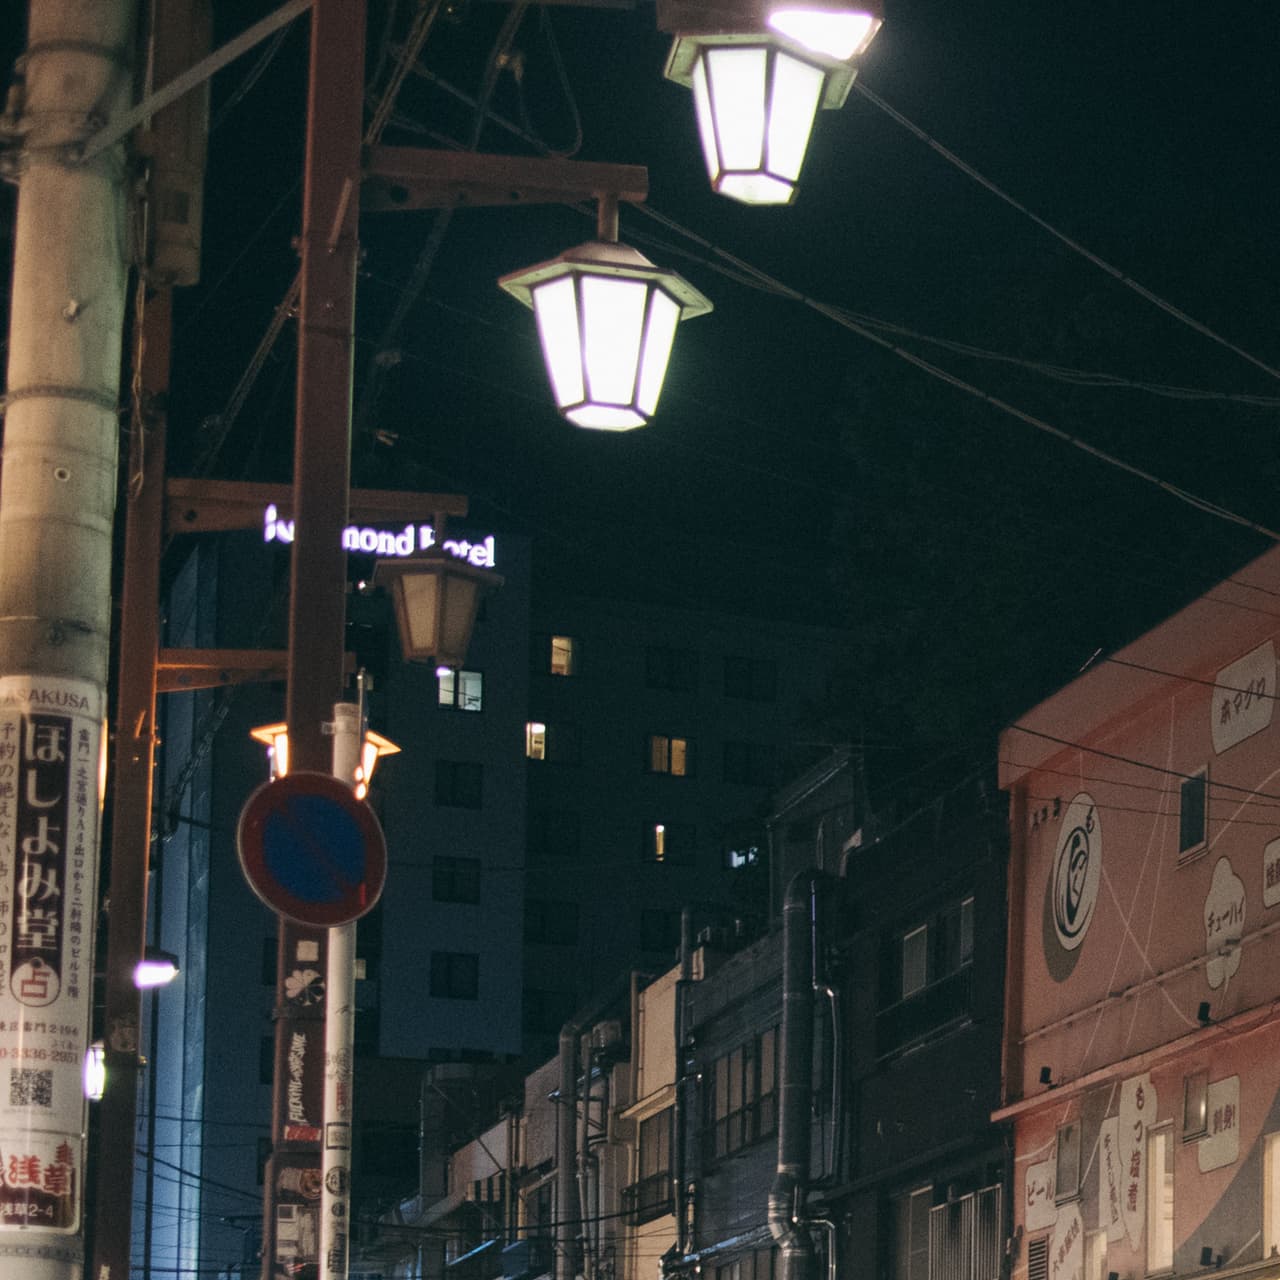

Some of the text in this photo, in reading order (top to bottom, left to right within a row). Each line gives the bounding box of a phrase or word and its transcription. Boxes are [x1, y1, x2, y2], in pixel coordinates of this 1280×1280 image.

[6, 688, 90, 711] ASAKUSA
[17, 721, 66, 950] ほしよみ堂
[20, 968, 50, 999] 占
